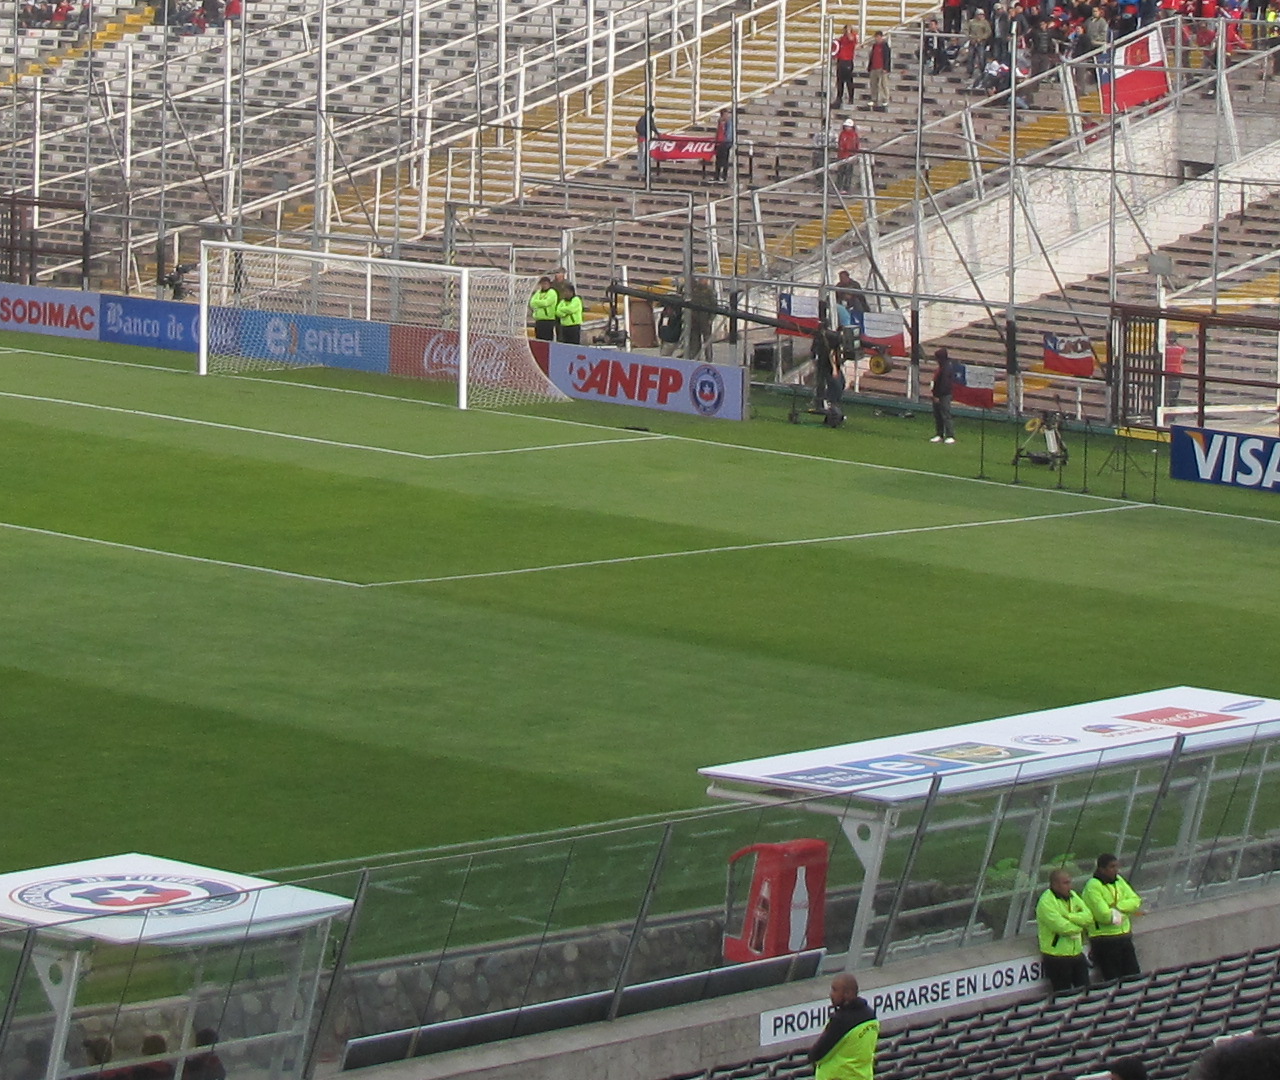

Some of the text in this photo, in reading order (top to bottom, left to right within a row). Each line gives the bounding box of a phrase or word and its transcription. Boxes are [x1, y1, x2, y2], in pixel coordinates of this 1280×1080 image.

[0, 297, 96, 332] SODIMAC
[105, 301, 160, 340] Banco
[167, 313, 185, 341] de
[304, 328, 363, 357] entel
[573, 359, 684, 405] ANFP
[772, 1004, 837, 1037] PROHI
[873, 980, 952, 1013] PARARSE
[955, 975, 979, 998] EN
[982, 966, 1015, 993] LOS
